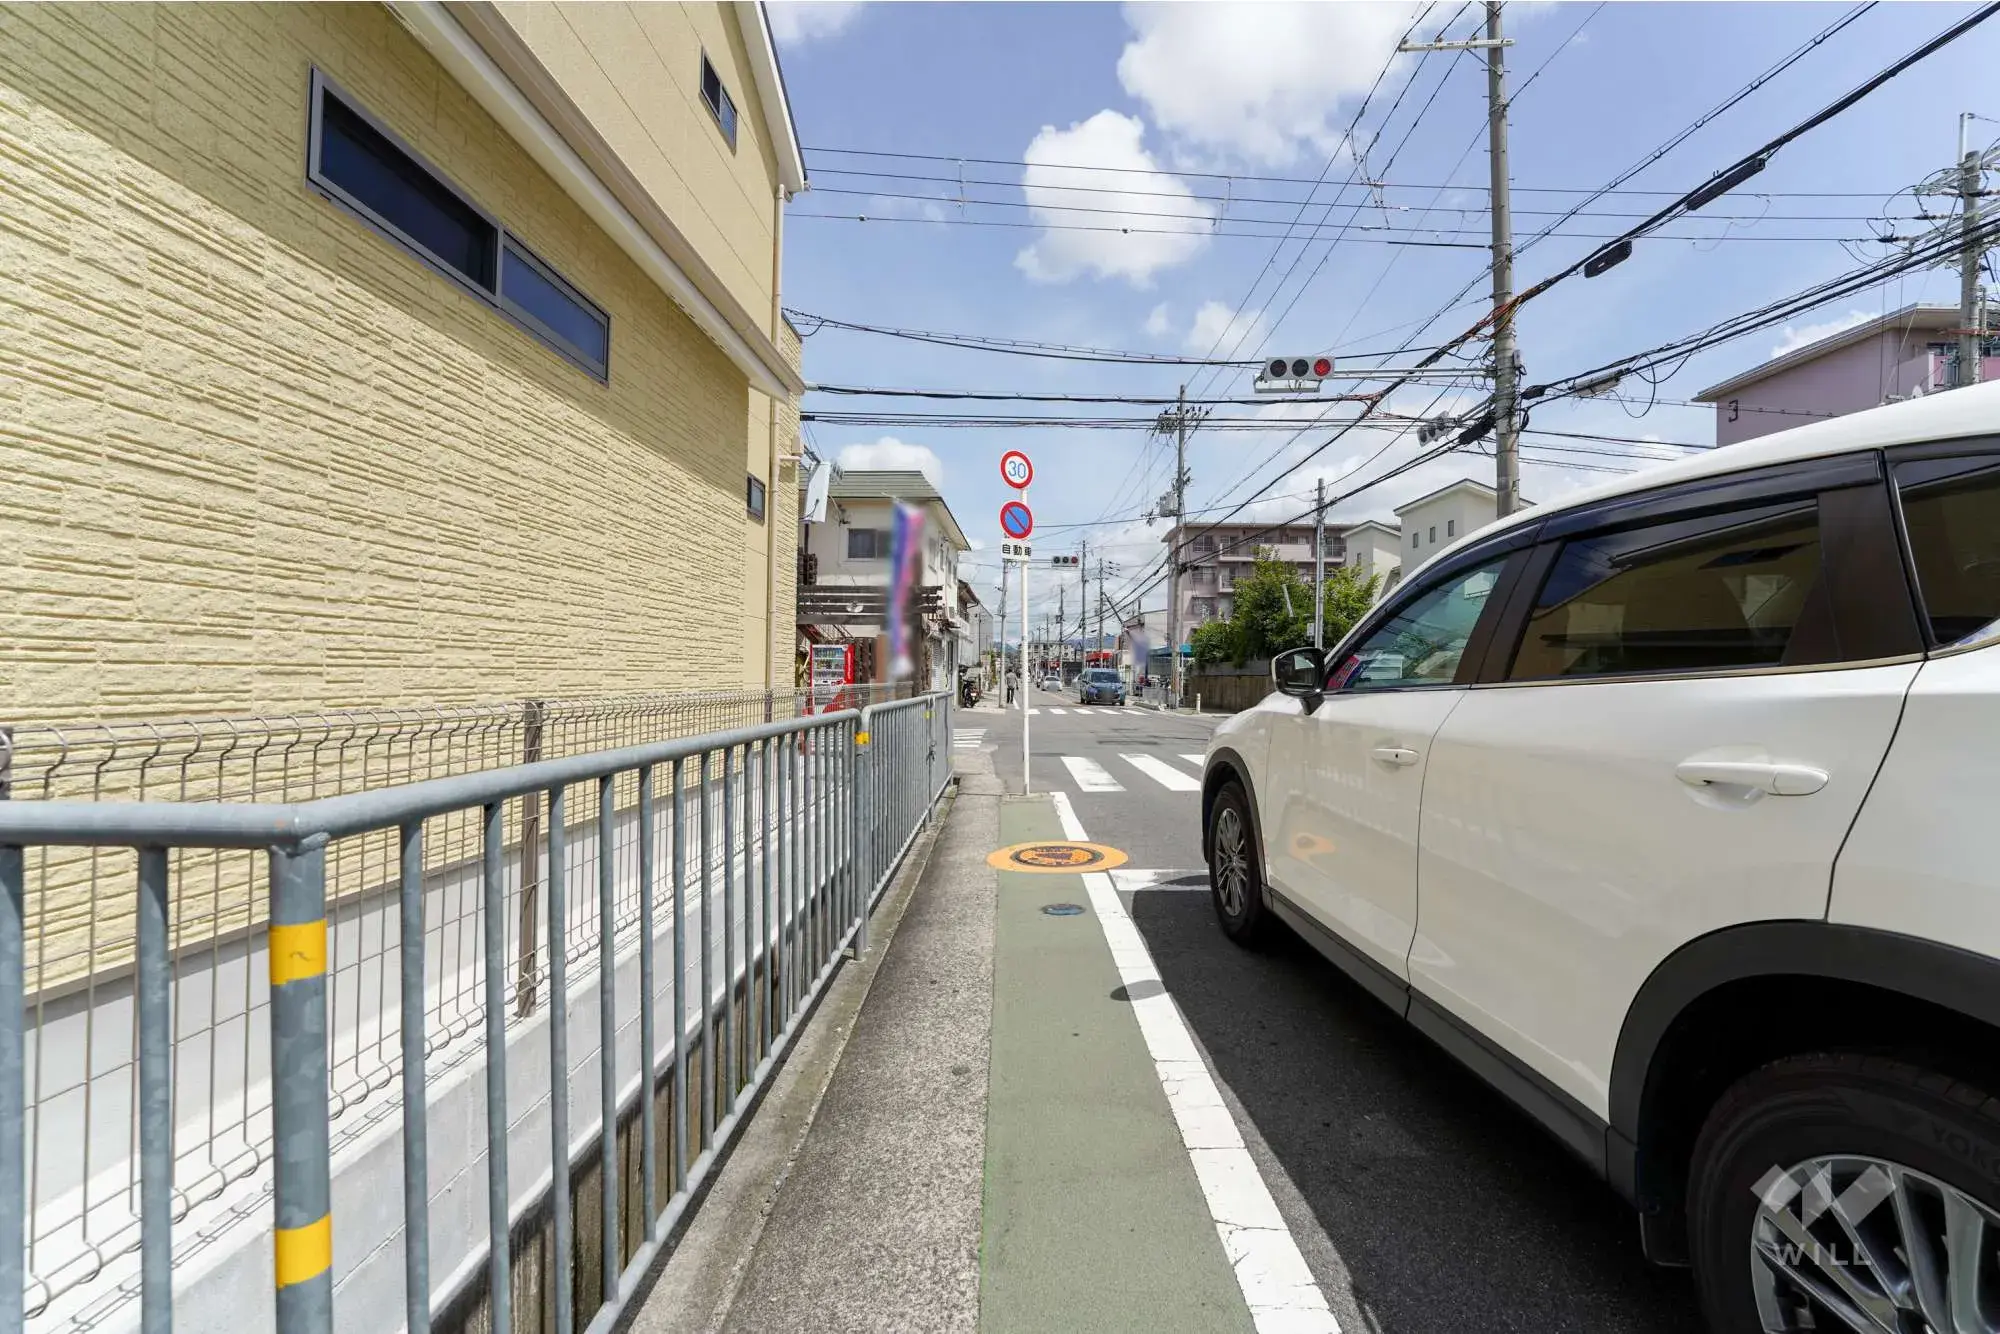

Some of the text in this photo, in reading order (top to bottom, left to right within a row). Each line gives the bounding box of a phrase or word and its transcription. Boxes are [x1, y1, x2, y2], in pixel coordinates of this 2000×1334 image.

[1008, 460, 1026, 479] 30
[1002, 544, 1032, 557] 自動車
